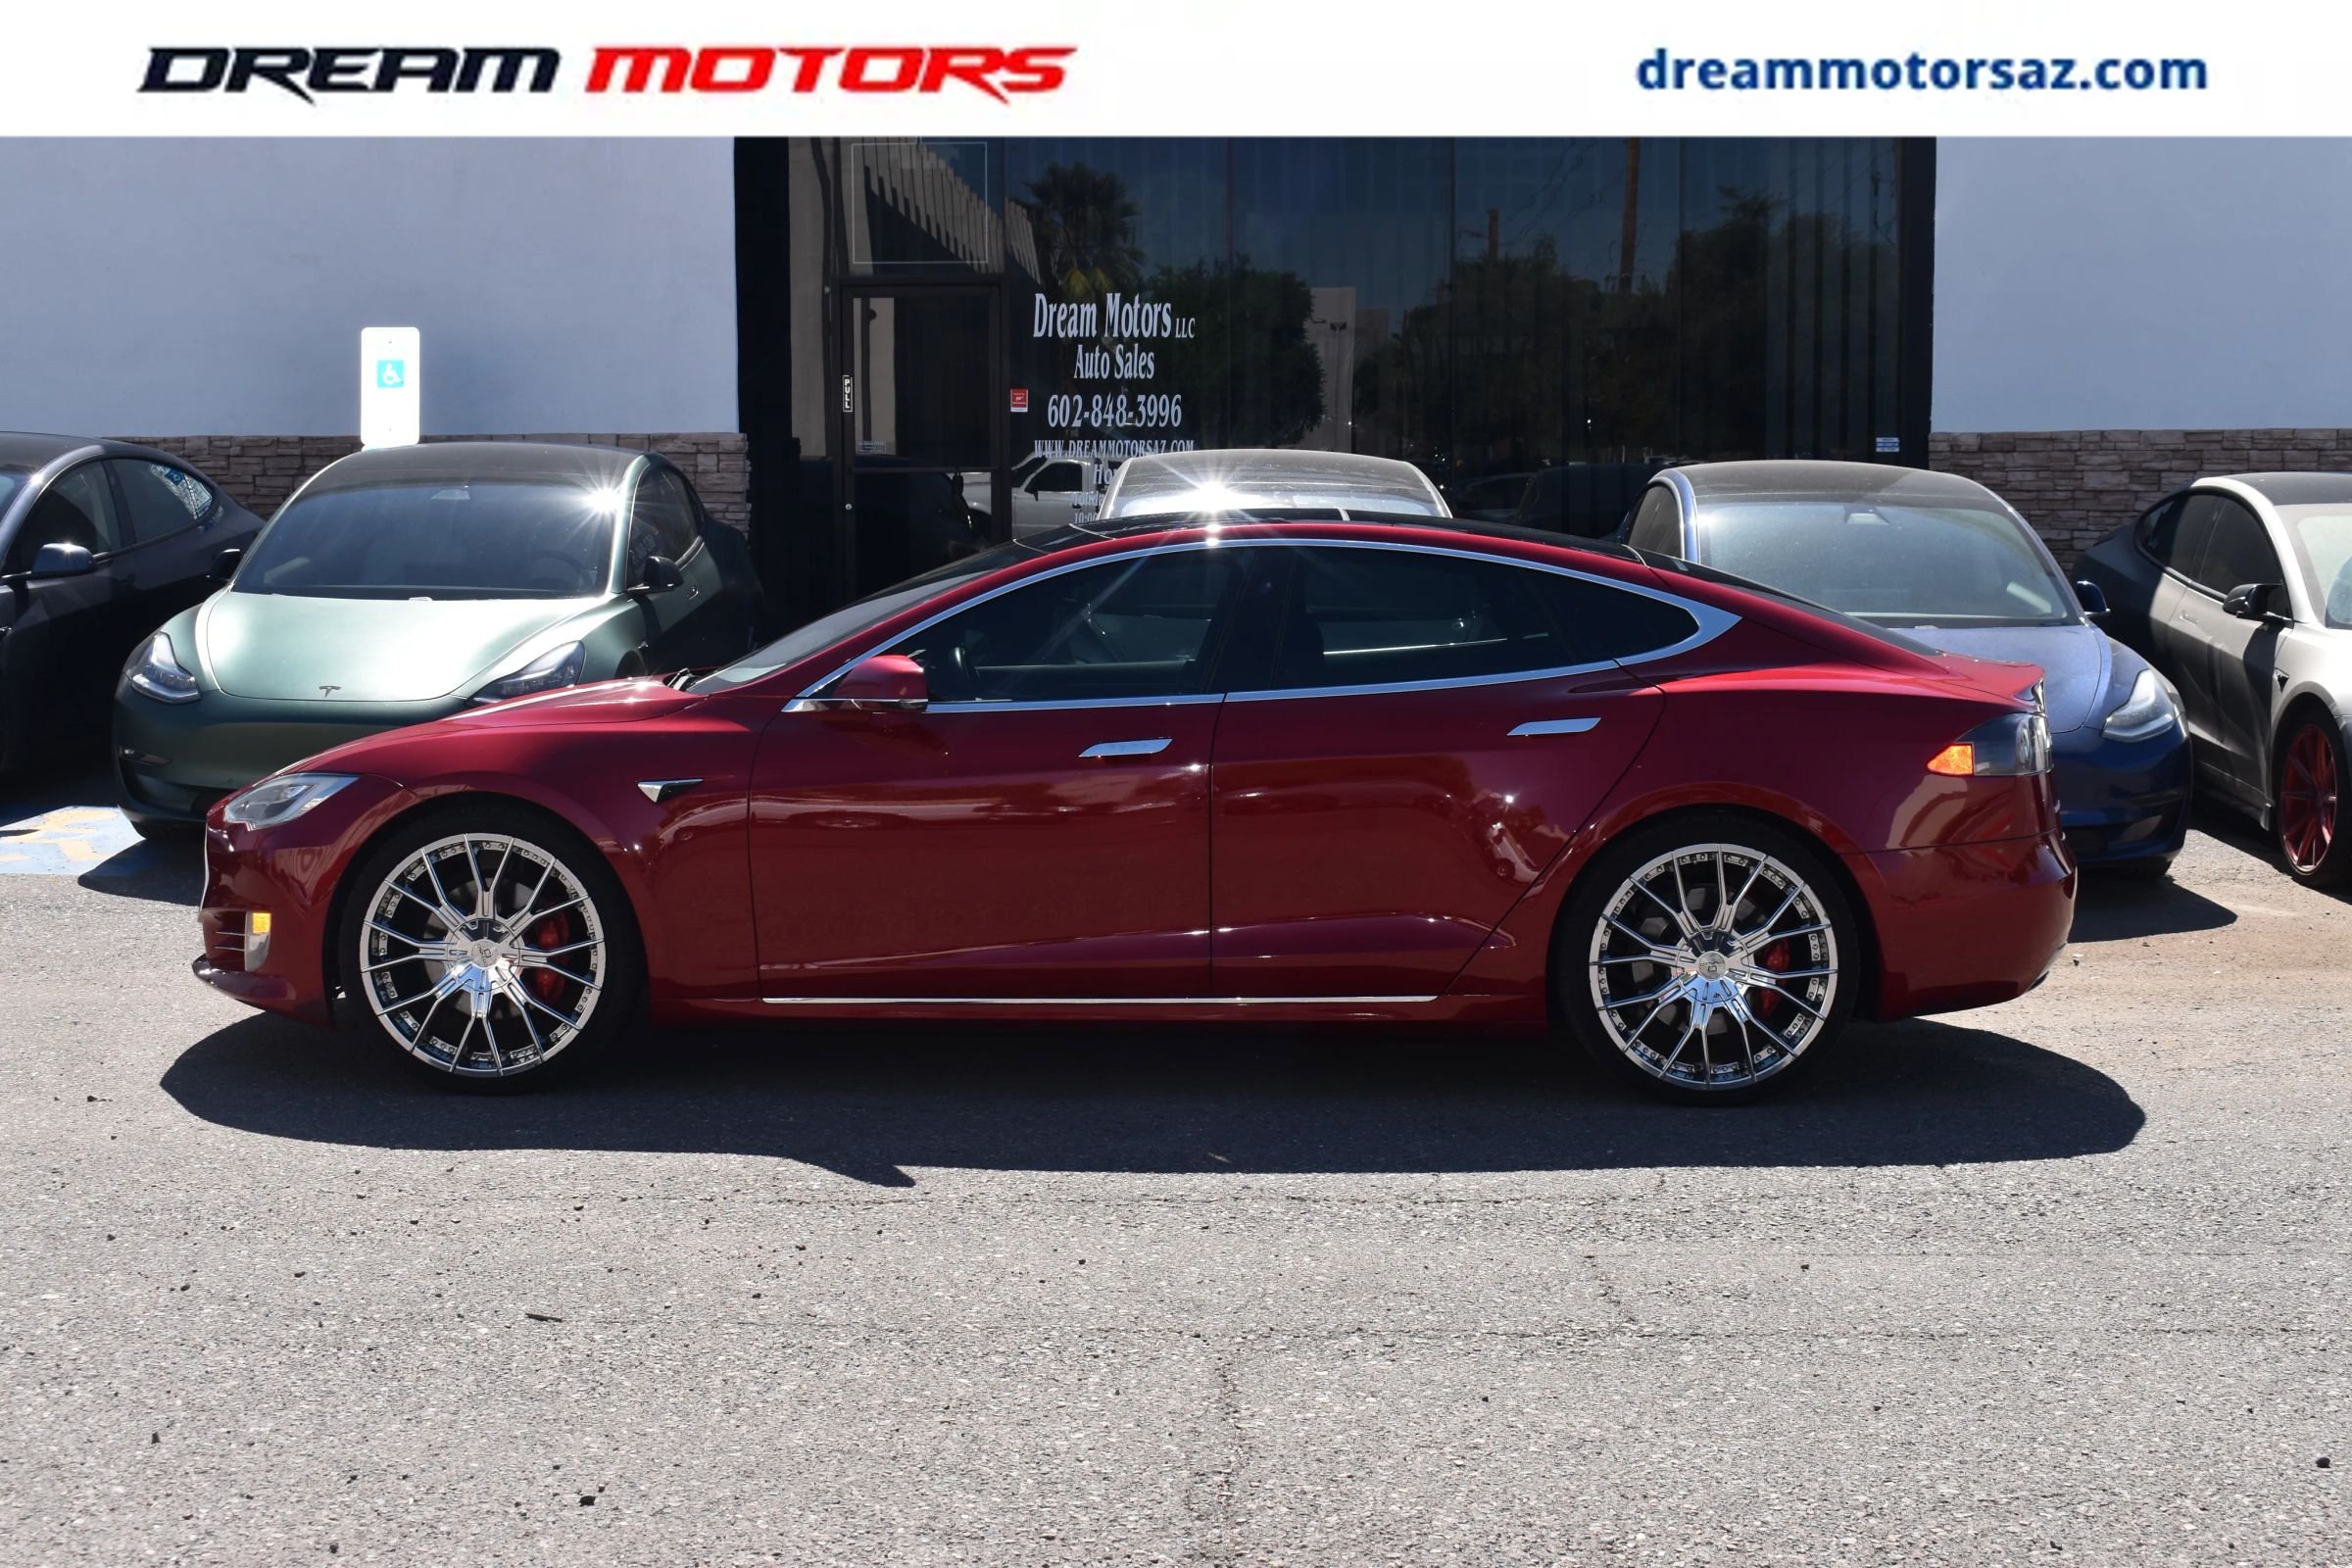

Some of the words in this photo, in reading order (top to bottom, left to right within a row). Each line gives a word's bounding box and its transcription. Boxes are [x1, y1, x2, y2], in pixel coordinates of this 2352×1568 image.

[1033, 293, 1098, 338] Dream
[1104, 292, 1172, 338] Motors
[1175, 318, 1196, 338] LLC
[1074, 344, 1110, 379] Auto
[1114, 343, 1155, 379] Sales
[1048, 393, 1182, 428] 602-848-3996
[1034, 440, 1195, 458] WWW.DREAMMOTORSAZCOM
